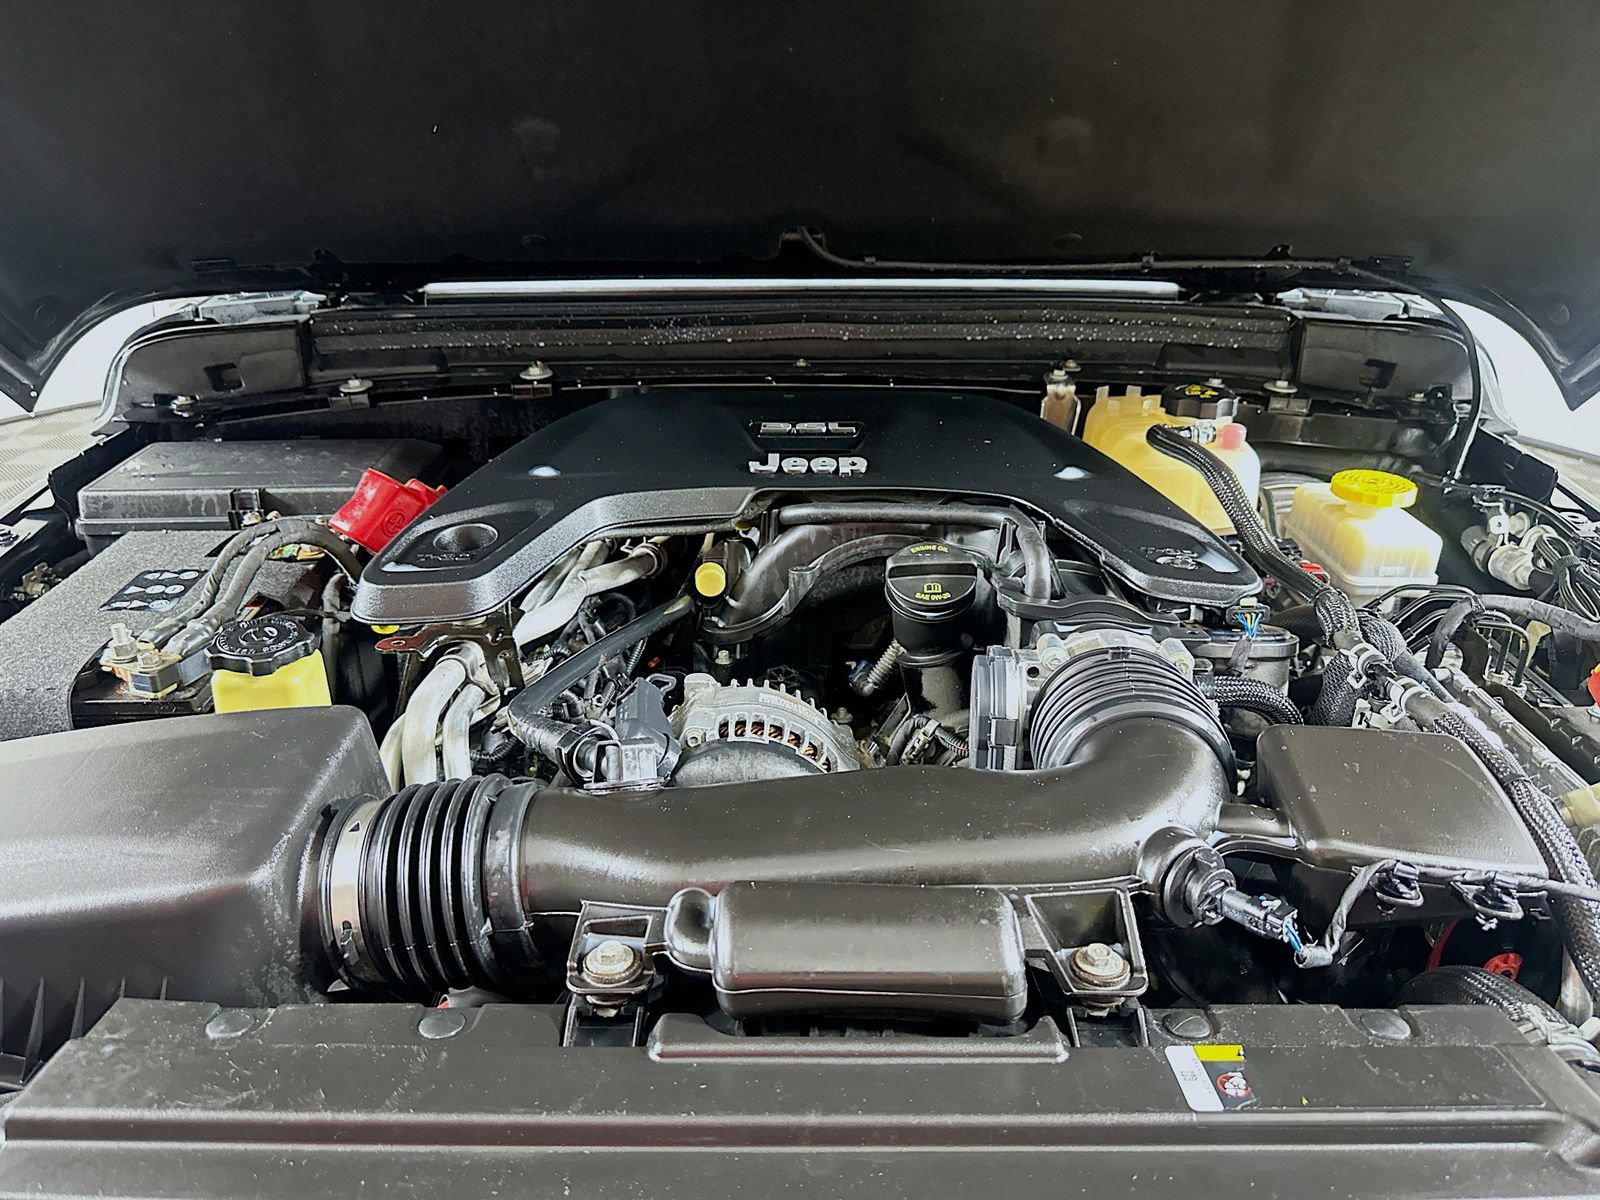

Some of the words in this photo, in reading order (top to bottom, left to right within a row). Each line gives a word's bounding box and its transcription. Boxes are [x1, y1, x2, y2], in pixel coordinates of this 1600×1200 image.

[748, 452, 868, 478] Jeep
[910, 544, 937, 554] ENGINE
[937, 544, 949, 553] OIL
[915, 592, 930, 601] SAE
[930, 592, 952, 601] 0W-20
